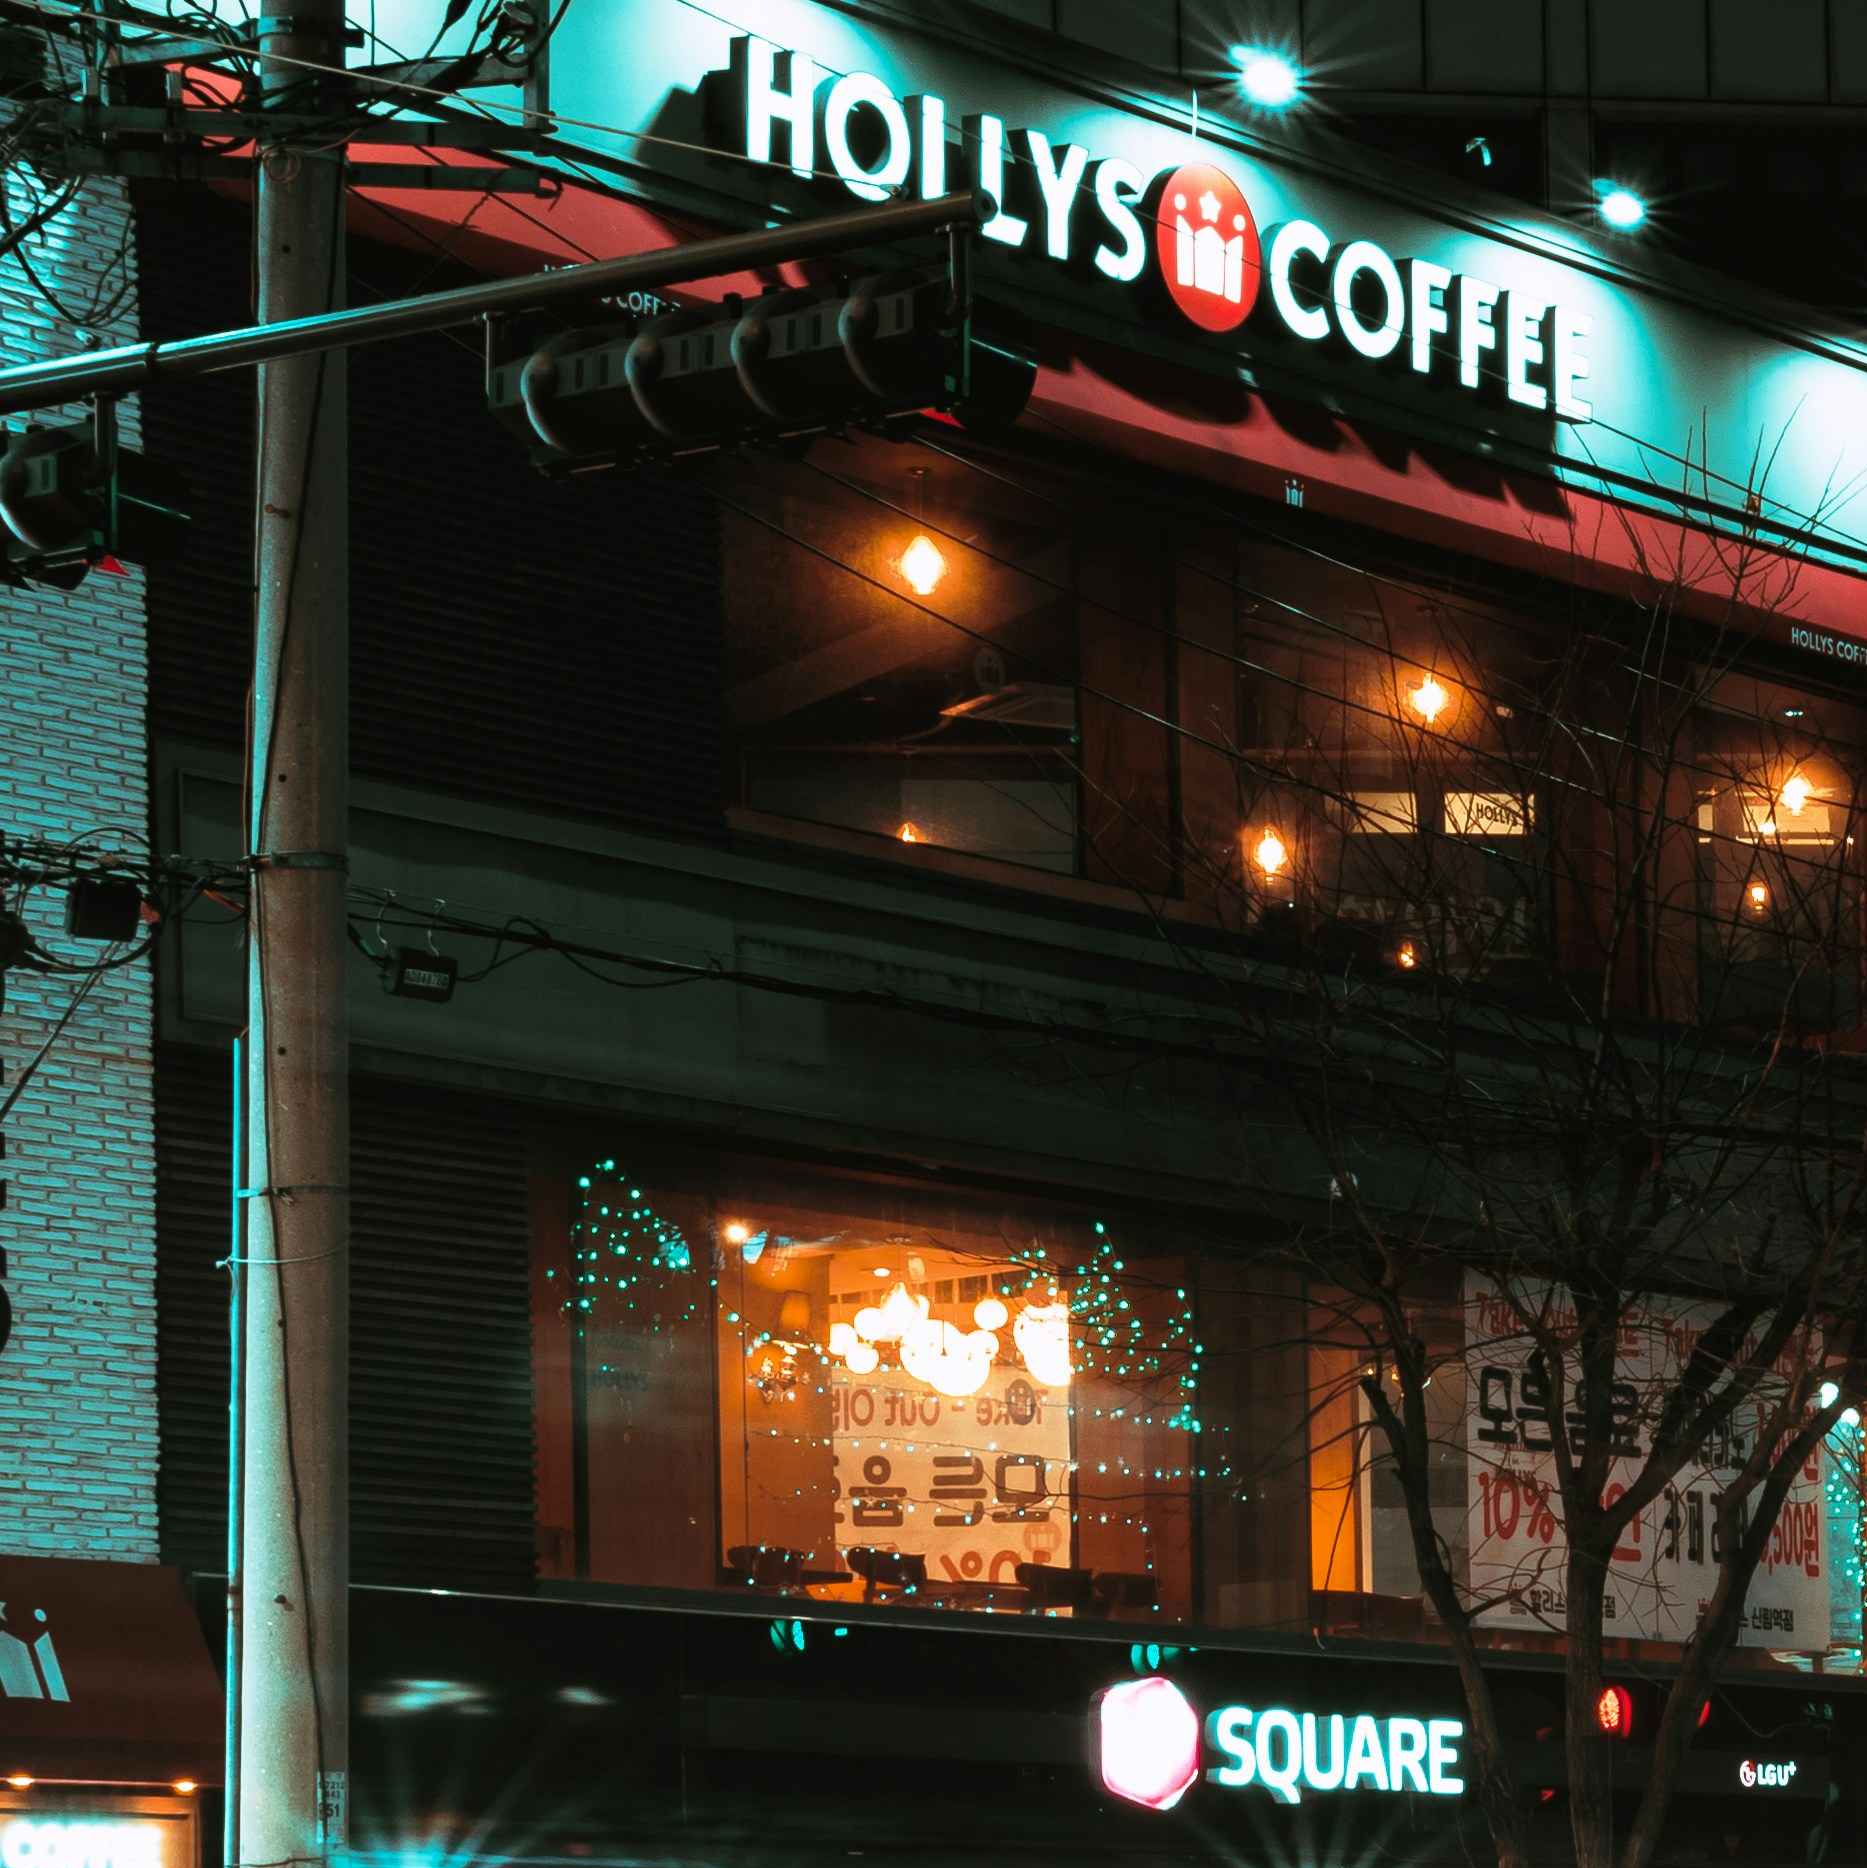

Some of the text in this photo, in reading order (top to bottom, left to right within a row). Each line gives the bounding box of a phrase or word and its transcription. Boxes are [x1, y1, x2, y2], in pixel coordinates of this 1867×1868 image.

[1269, 218, 1595, 424] COFFEE
[1791, 626, 1833, 655] HOLLYS
[1479, 1472, 1555, 1544] 10%
[1217, 1706, 1464, 1804] SQUARE
